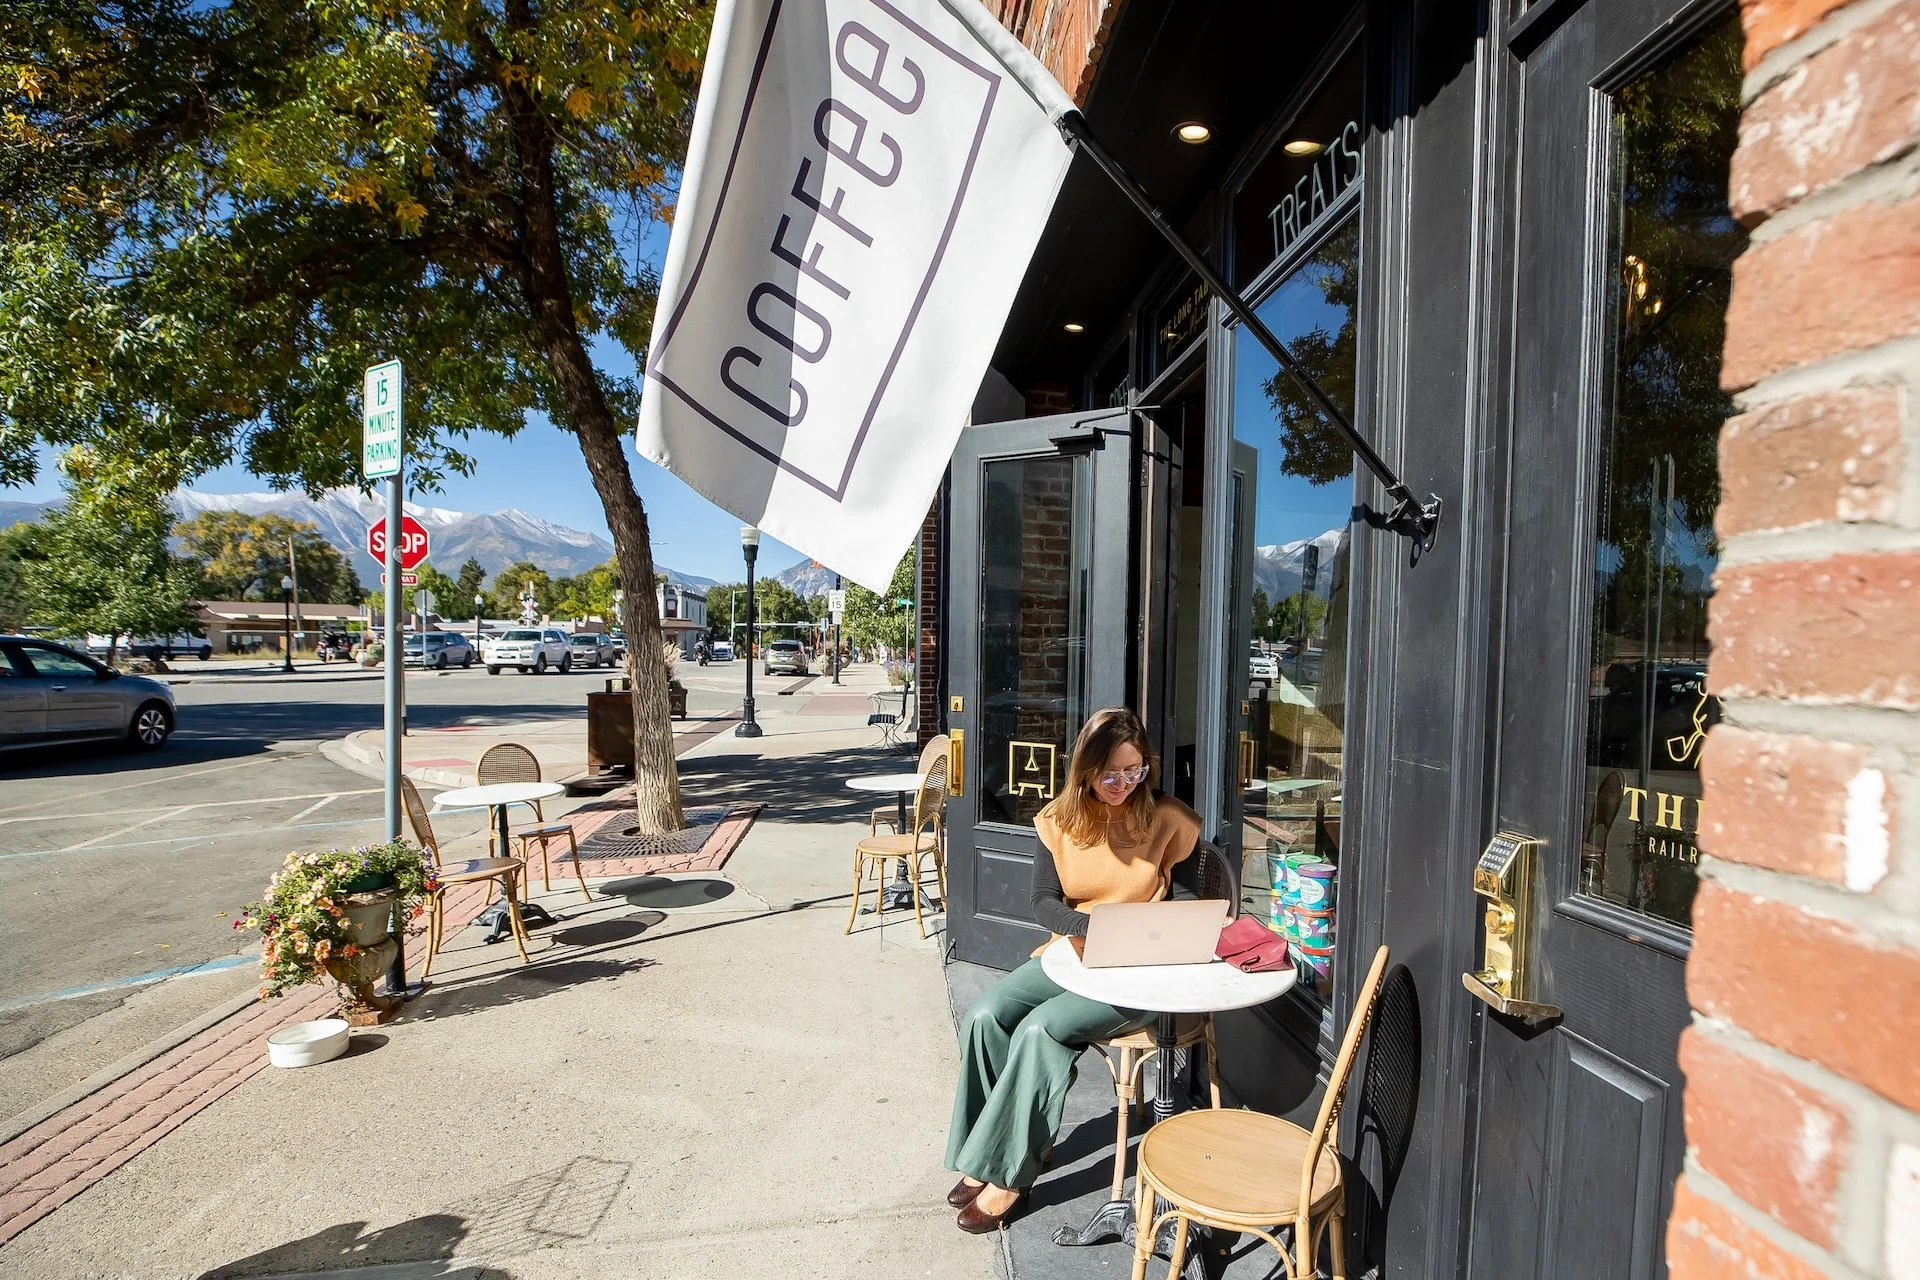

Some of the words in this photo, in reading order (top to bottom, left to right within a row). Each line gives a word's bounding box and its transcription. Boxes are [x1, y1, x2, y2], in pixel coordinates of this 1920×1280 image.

[1267, 120, 1361, 258] TREATS
[1173, 296, 1192, 330] LONG
[1194, 279, 1209, 307] TAB
[376, 378, 388, 406] 15
[368, 410, 396, 432] MINUTE
[366, 439, 397, 463] PARKING
[372, 531, 426, 554] SOP
[1648, 836, 1698, 865] RAILR
